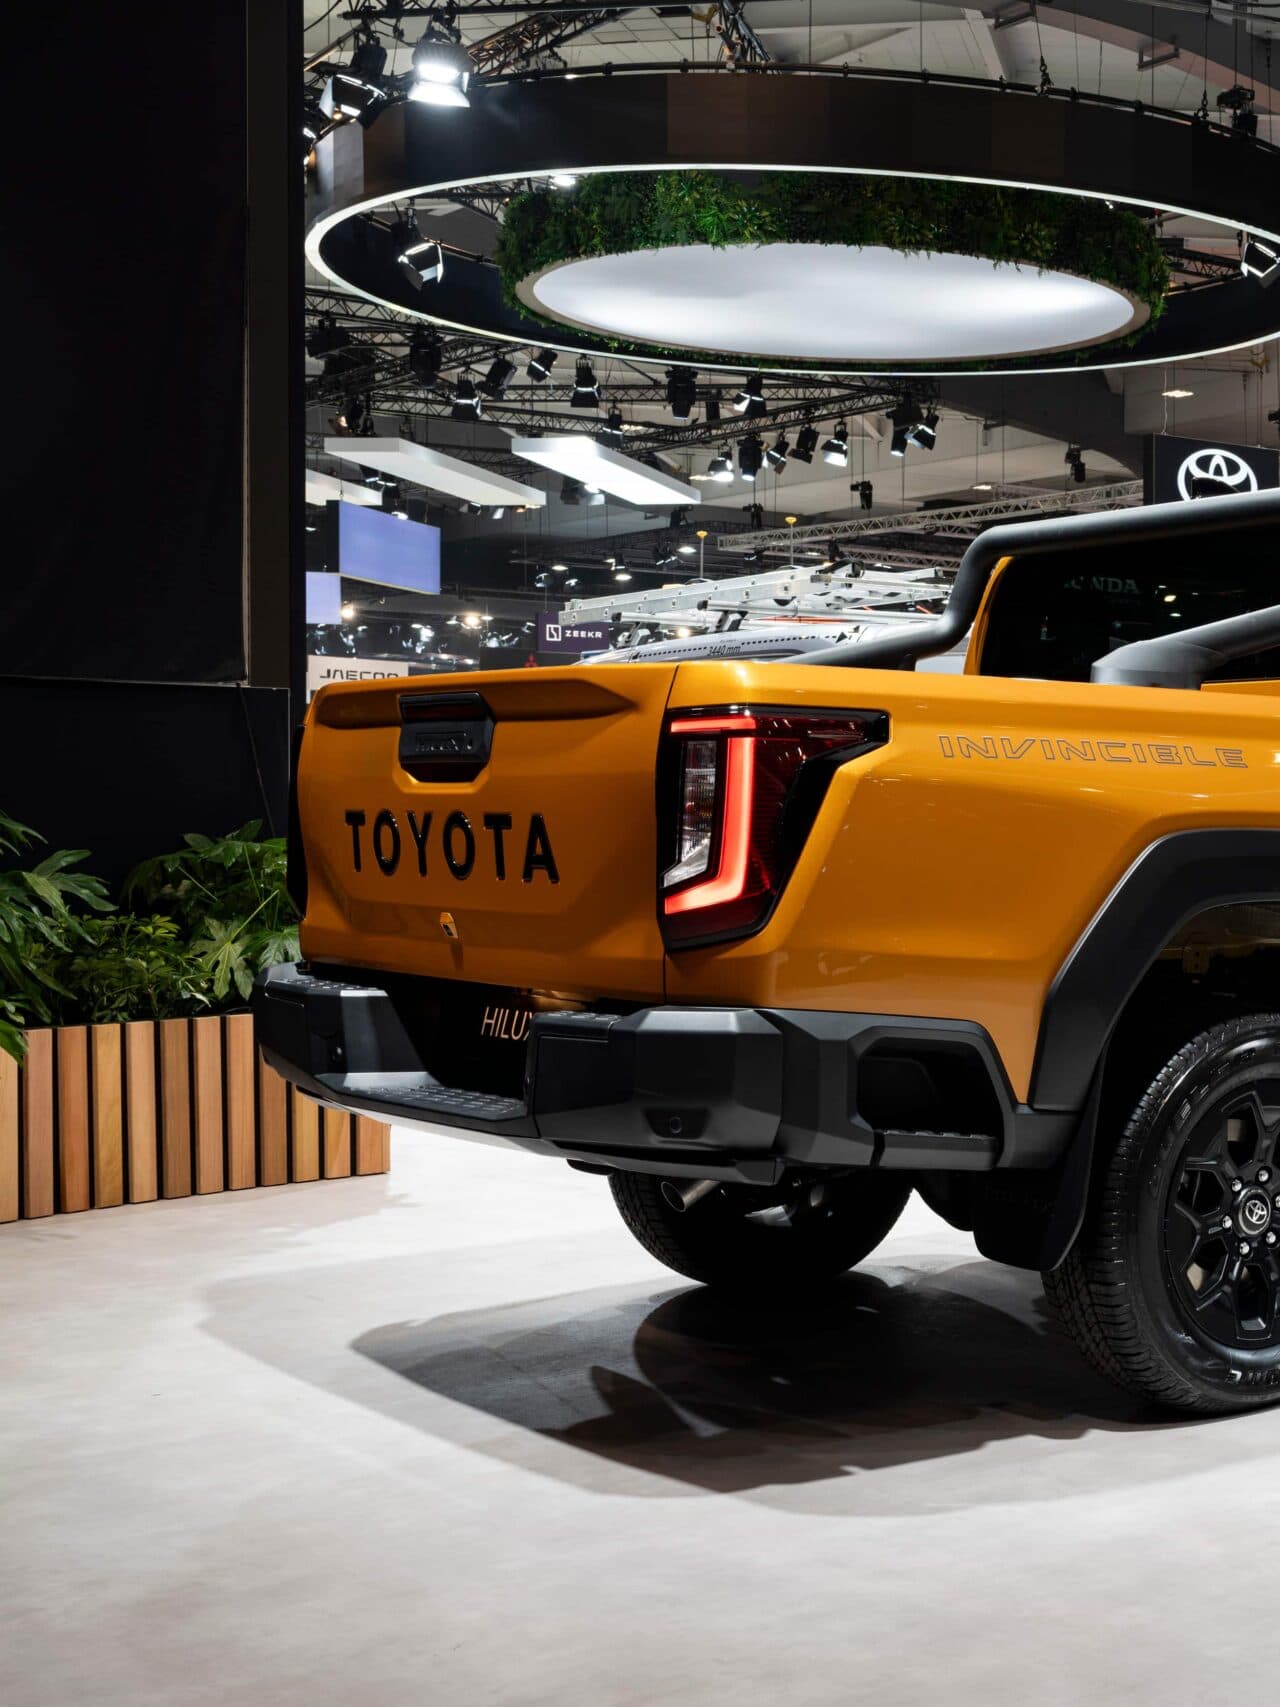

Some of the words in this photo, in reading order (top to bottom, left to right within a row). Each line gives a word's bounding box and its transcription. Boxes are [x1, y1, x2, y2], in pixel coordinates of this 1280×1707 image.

[565, 630, 603, 639] ZEEKR
[938, 735, 1249, 768] INVINCIBLE
[344, 808, 561, 884] TOYOTA
